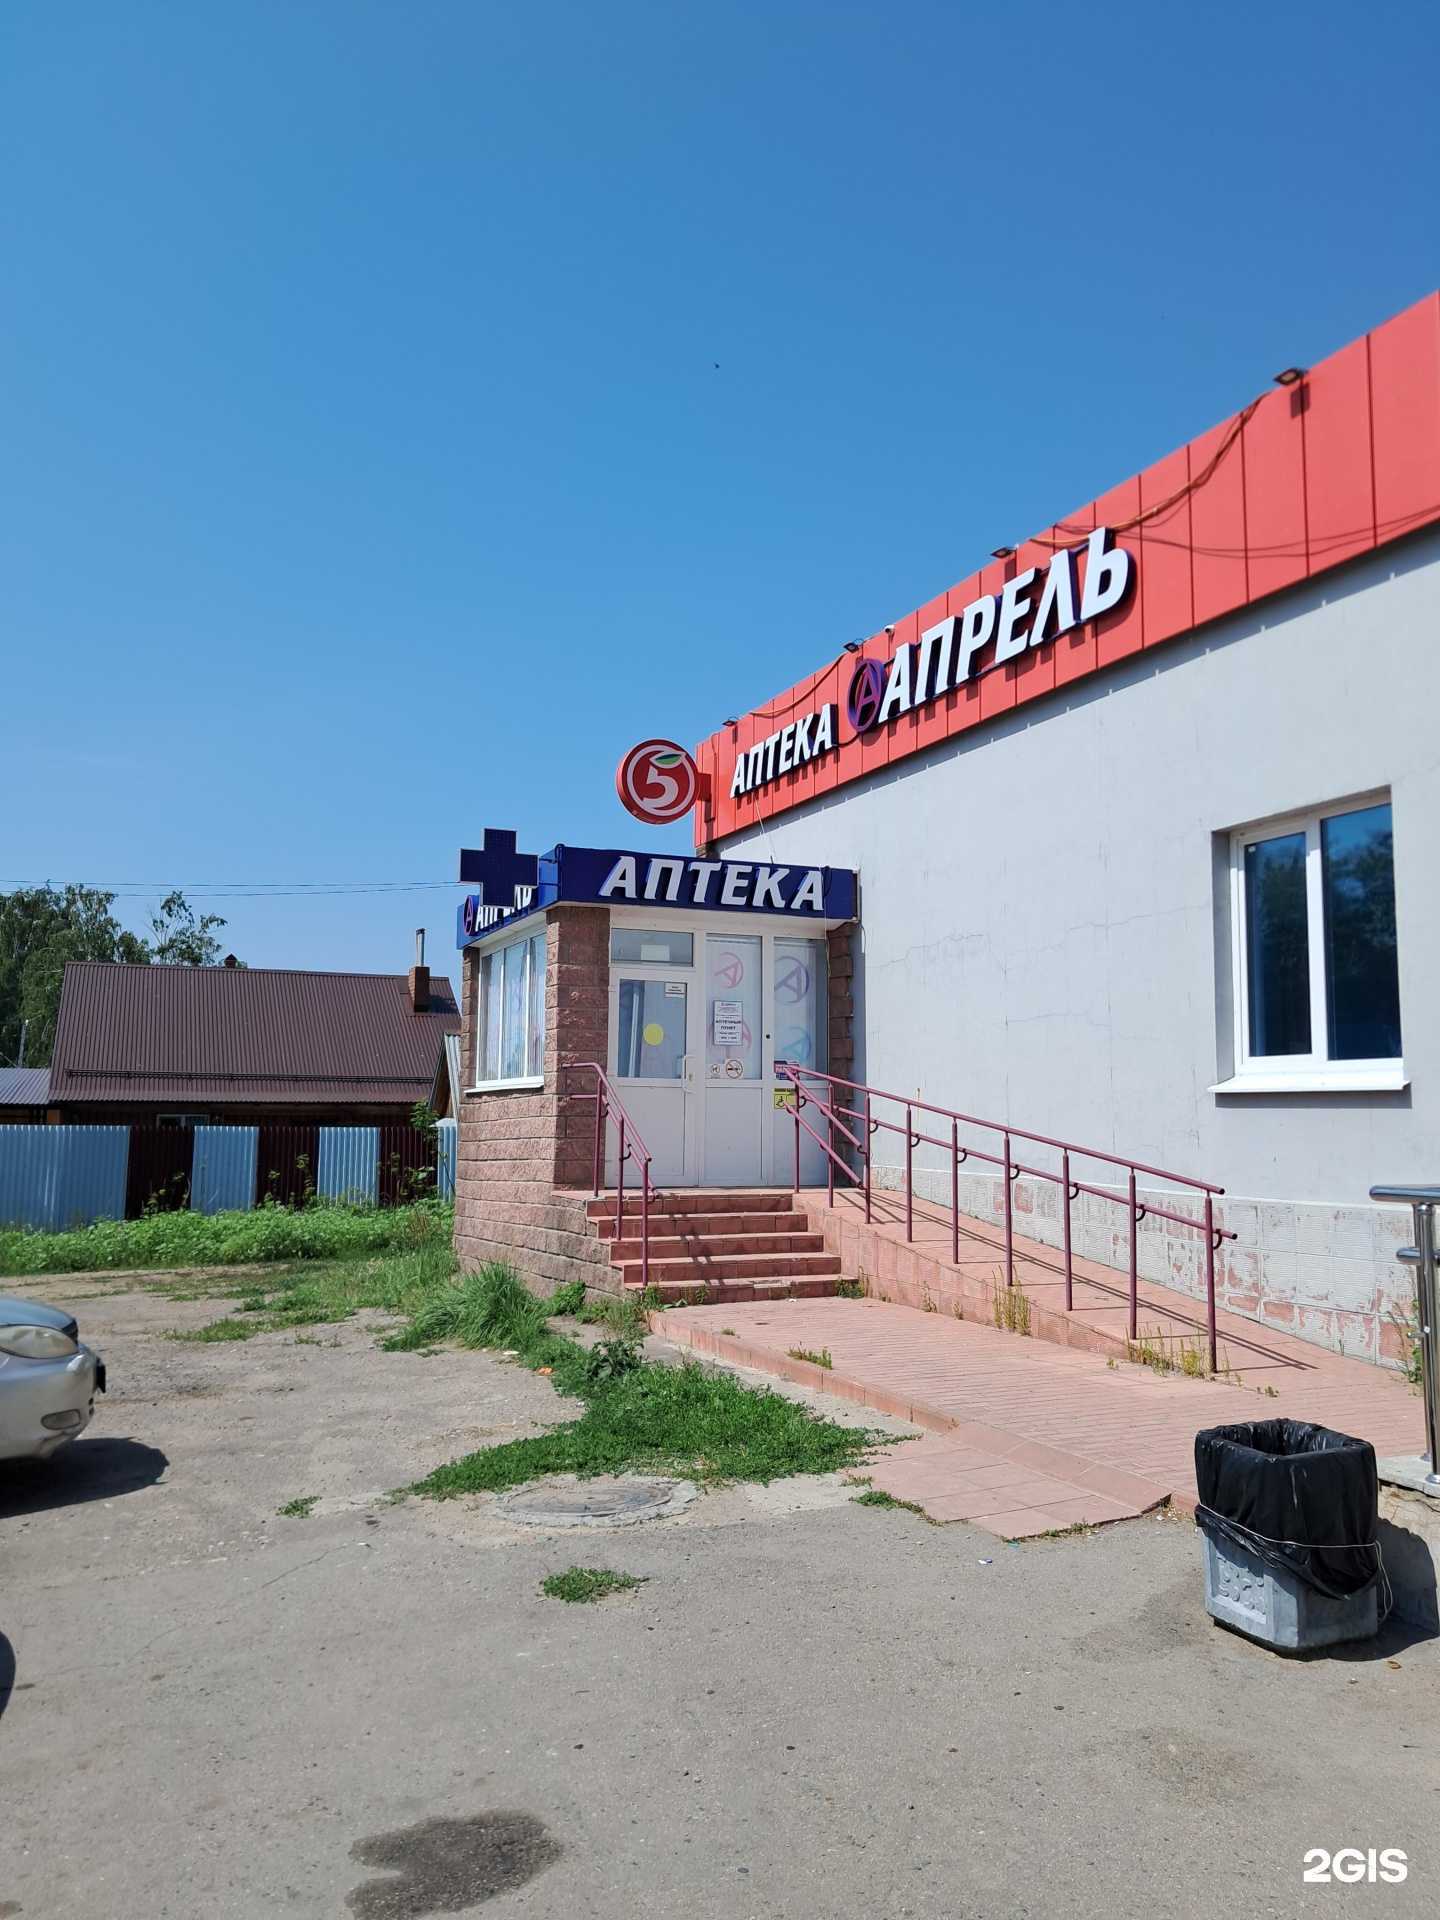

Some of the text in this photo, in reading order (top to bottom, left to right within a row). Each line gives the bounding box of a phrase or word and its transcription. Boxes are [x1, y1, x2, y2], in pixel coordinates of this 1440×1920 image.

[730, 703, 837, 799] АПТЕКА
[878, 527, 1134, 723] АПРЕЛЬ
[642, 763, 679, 809] 5
[599, 855, 825, 911] АПТЕКА
